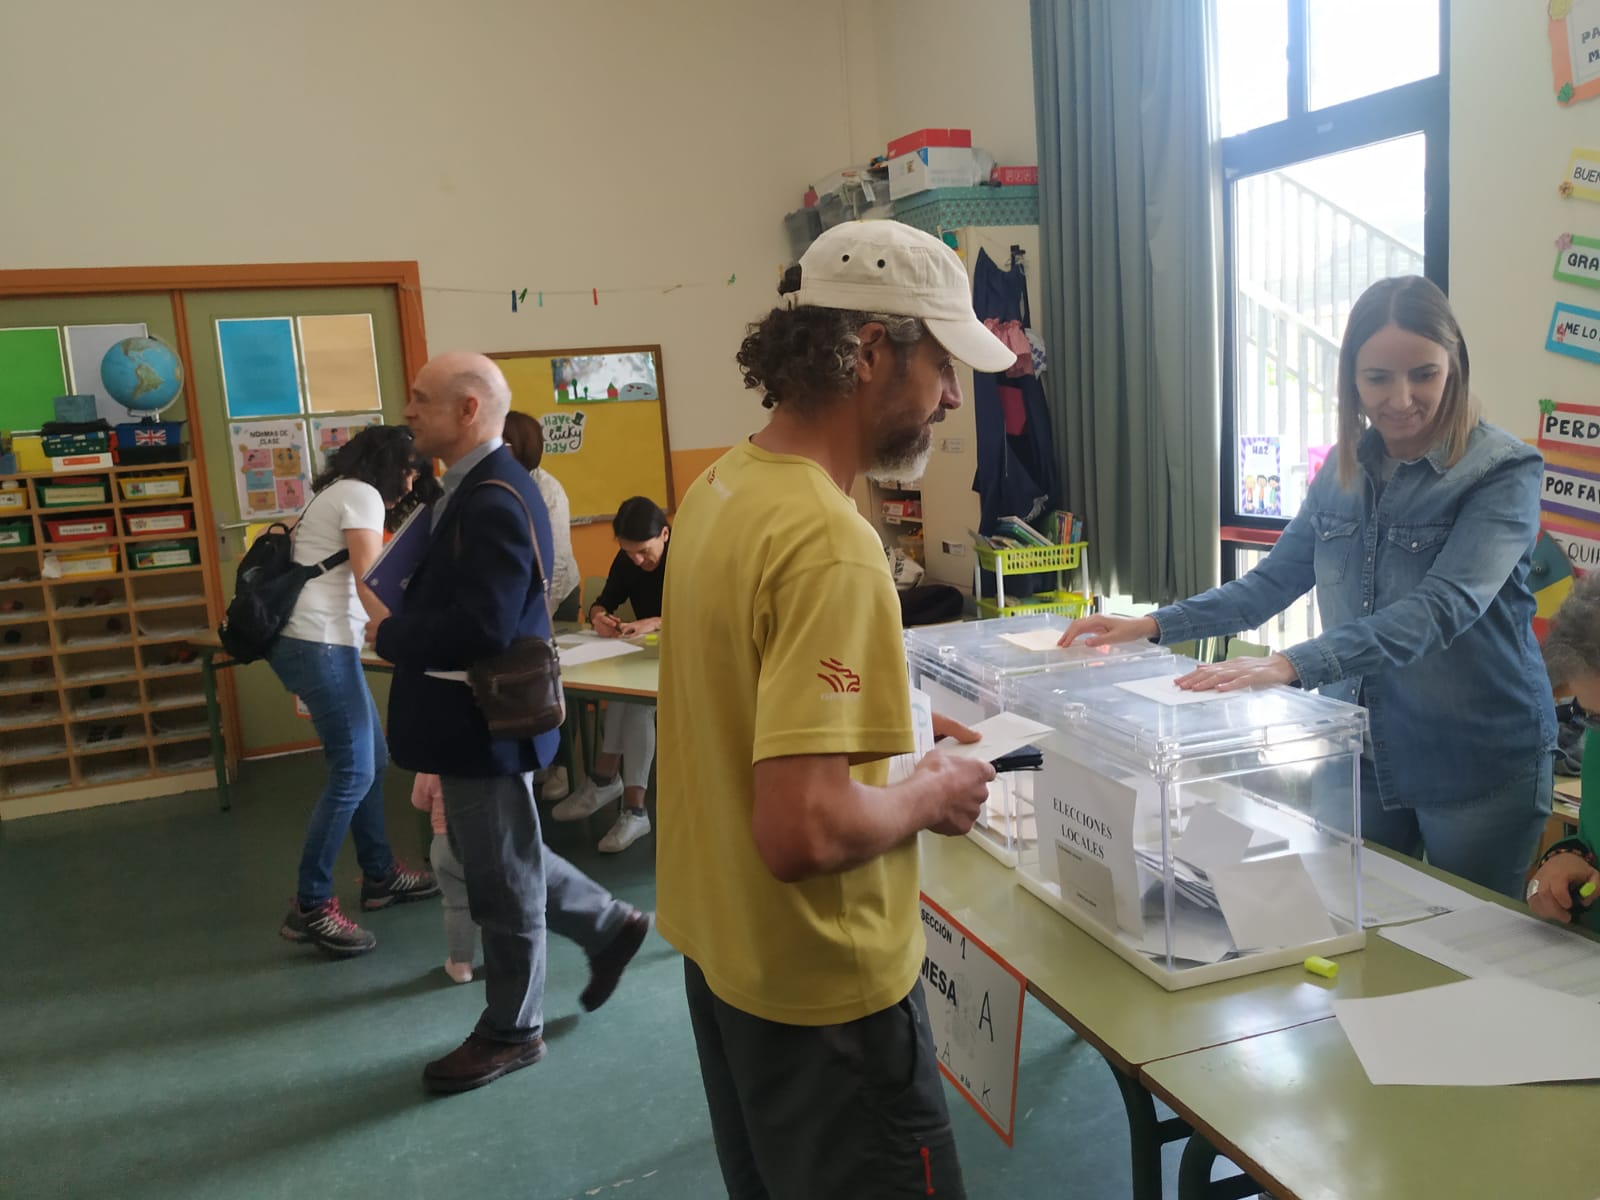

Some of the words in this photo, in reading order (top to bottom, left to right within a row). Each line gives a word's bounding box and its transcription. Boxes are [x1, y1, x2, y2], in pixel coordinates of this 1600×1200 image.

[1567, 253, 1600, 271] GRA
[1564, 321, 1580, 336] ME
[1581, 325, 1598, 340] LO
[1545, 416, 1600, 439] PERD
[1545, 476, 1574, 496] POR
[1053, 797, 1112, 840] ELECCIONES
[1061, 824, 1105, 860] LOCALES
[921, 908, 952, 944] SECCIÓN
[921, 956, 957, 1007] MESA
[978, 990, 994, 1042] A
